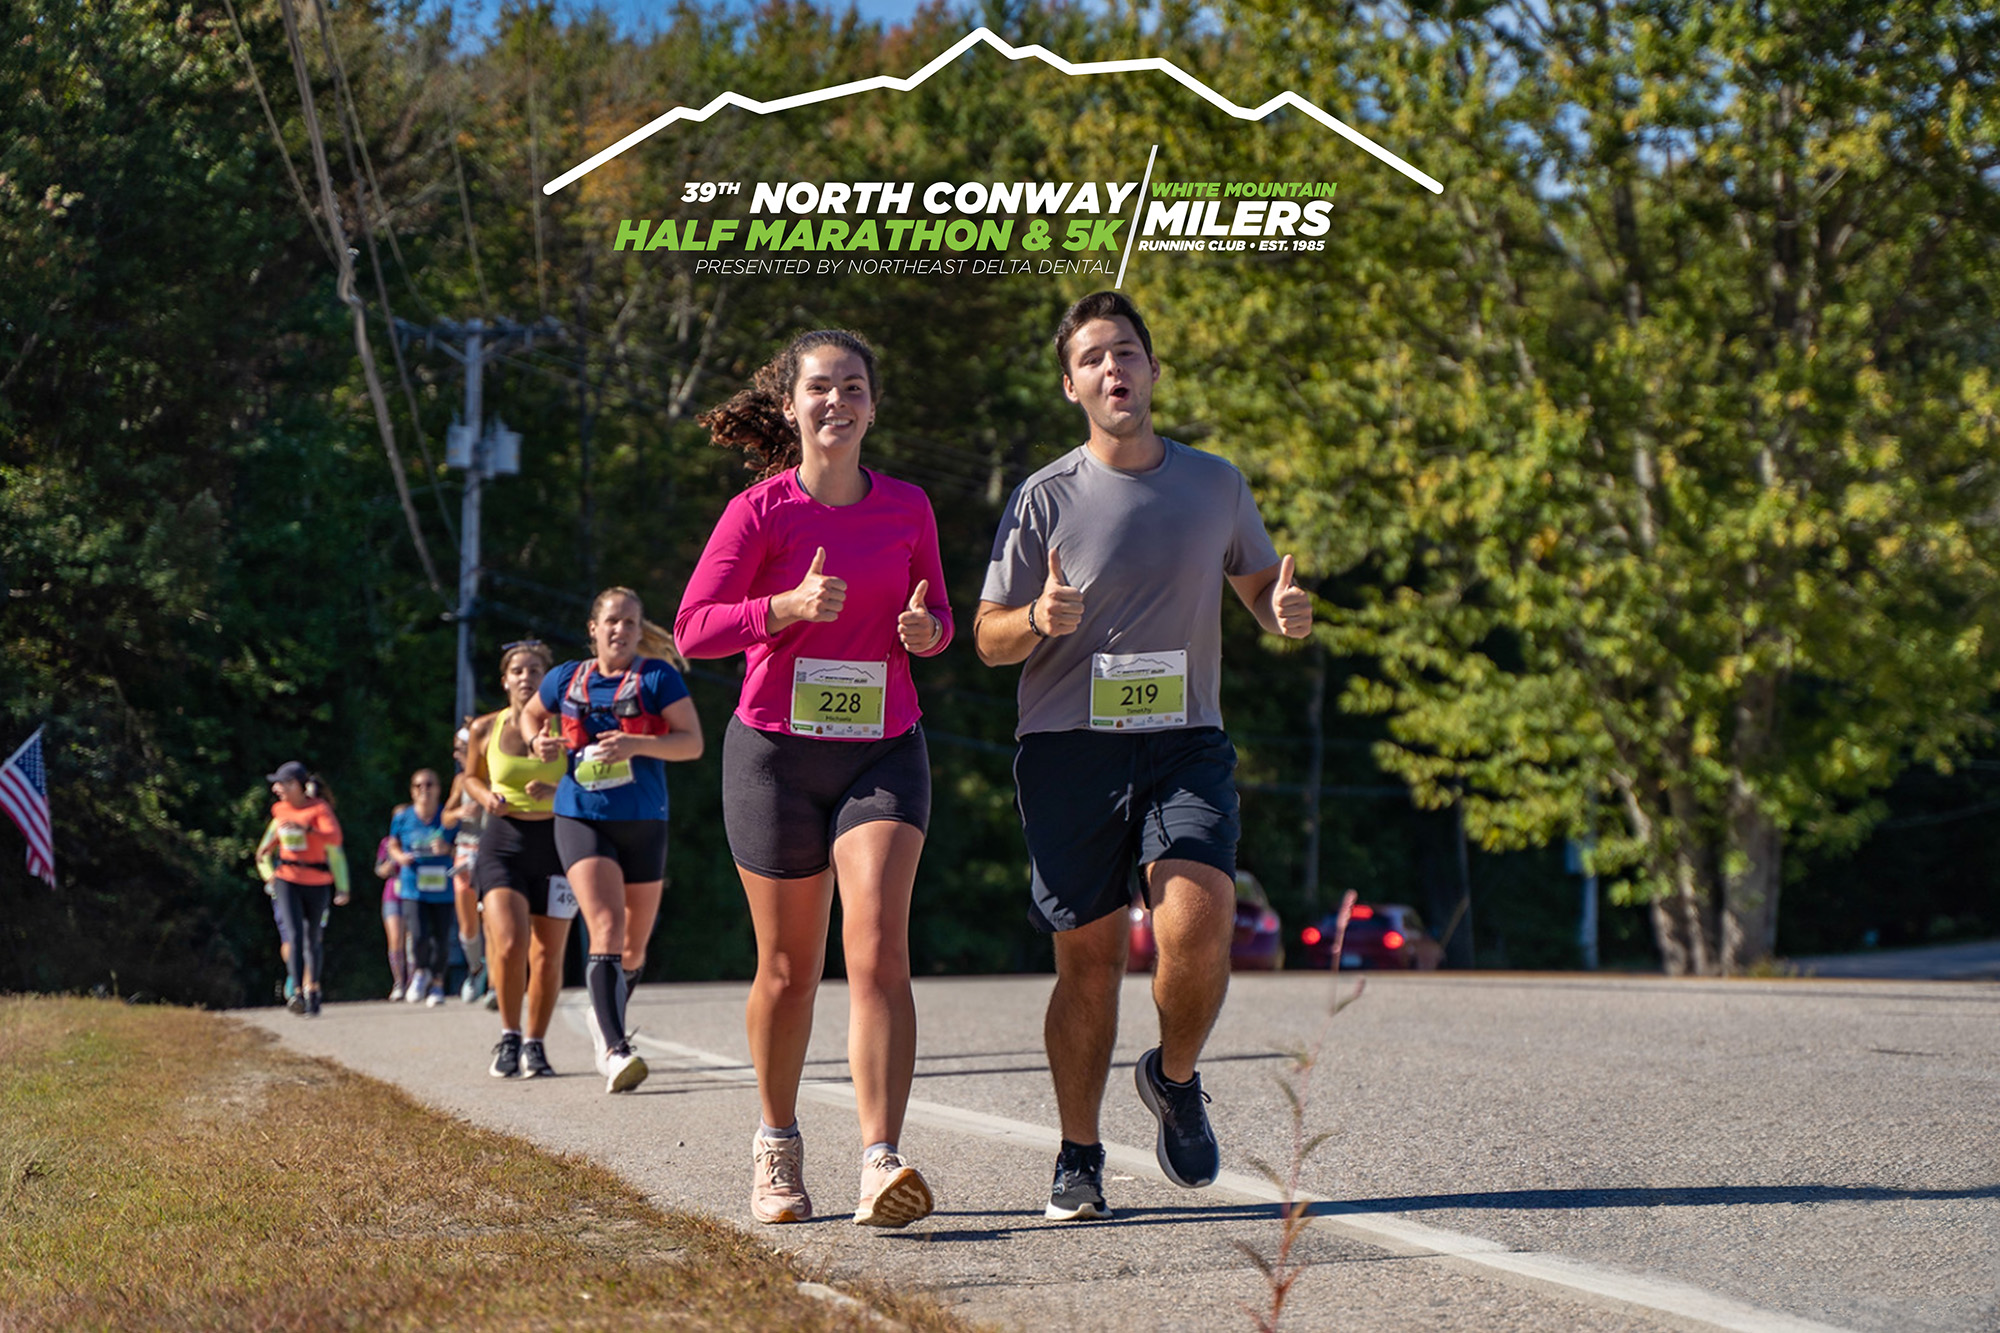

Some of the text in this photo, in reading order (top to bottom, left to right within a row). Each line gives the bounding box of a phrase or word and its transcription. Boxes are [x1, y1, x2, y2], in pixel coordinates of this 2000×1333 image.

[819, 691, 861, 714] 228
[1120, 684, 1158, 706] 219
[557, 892, 578, 907] 49
